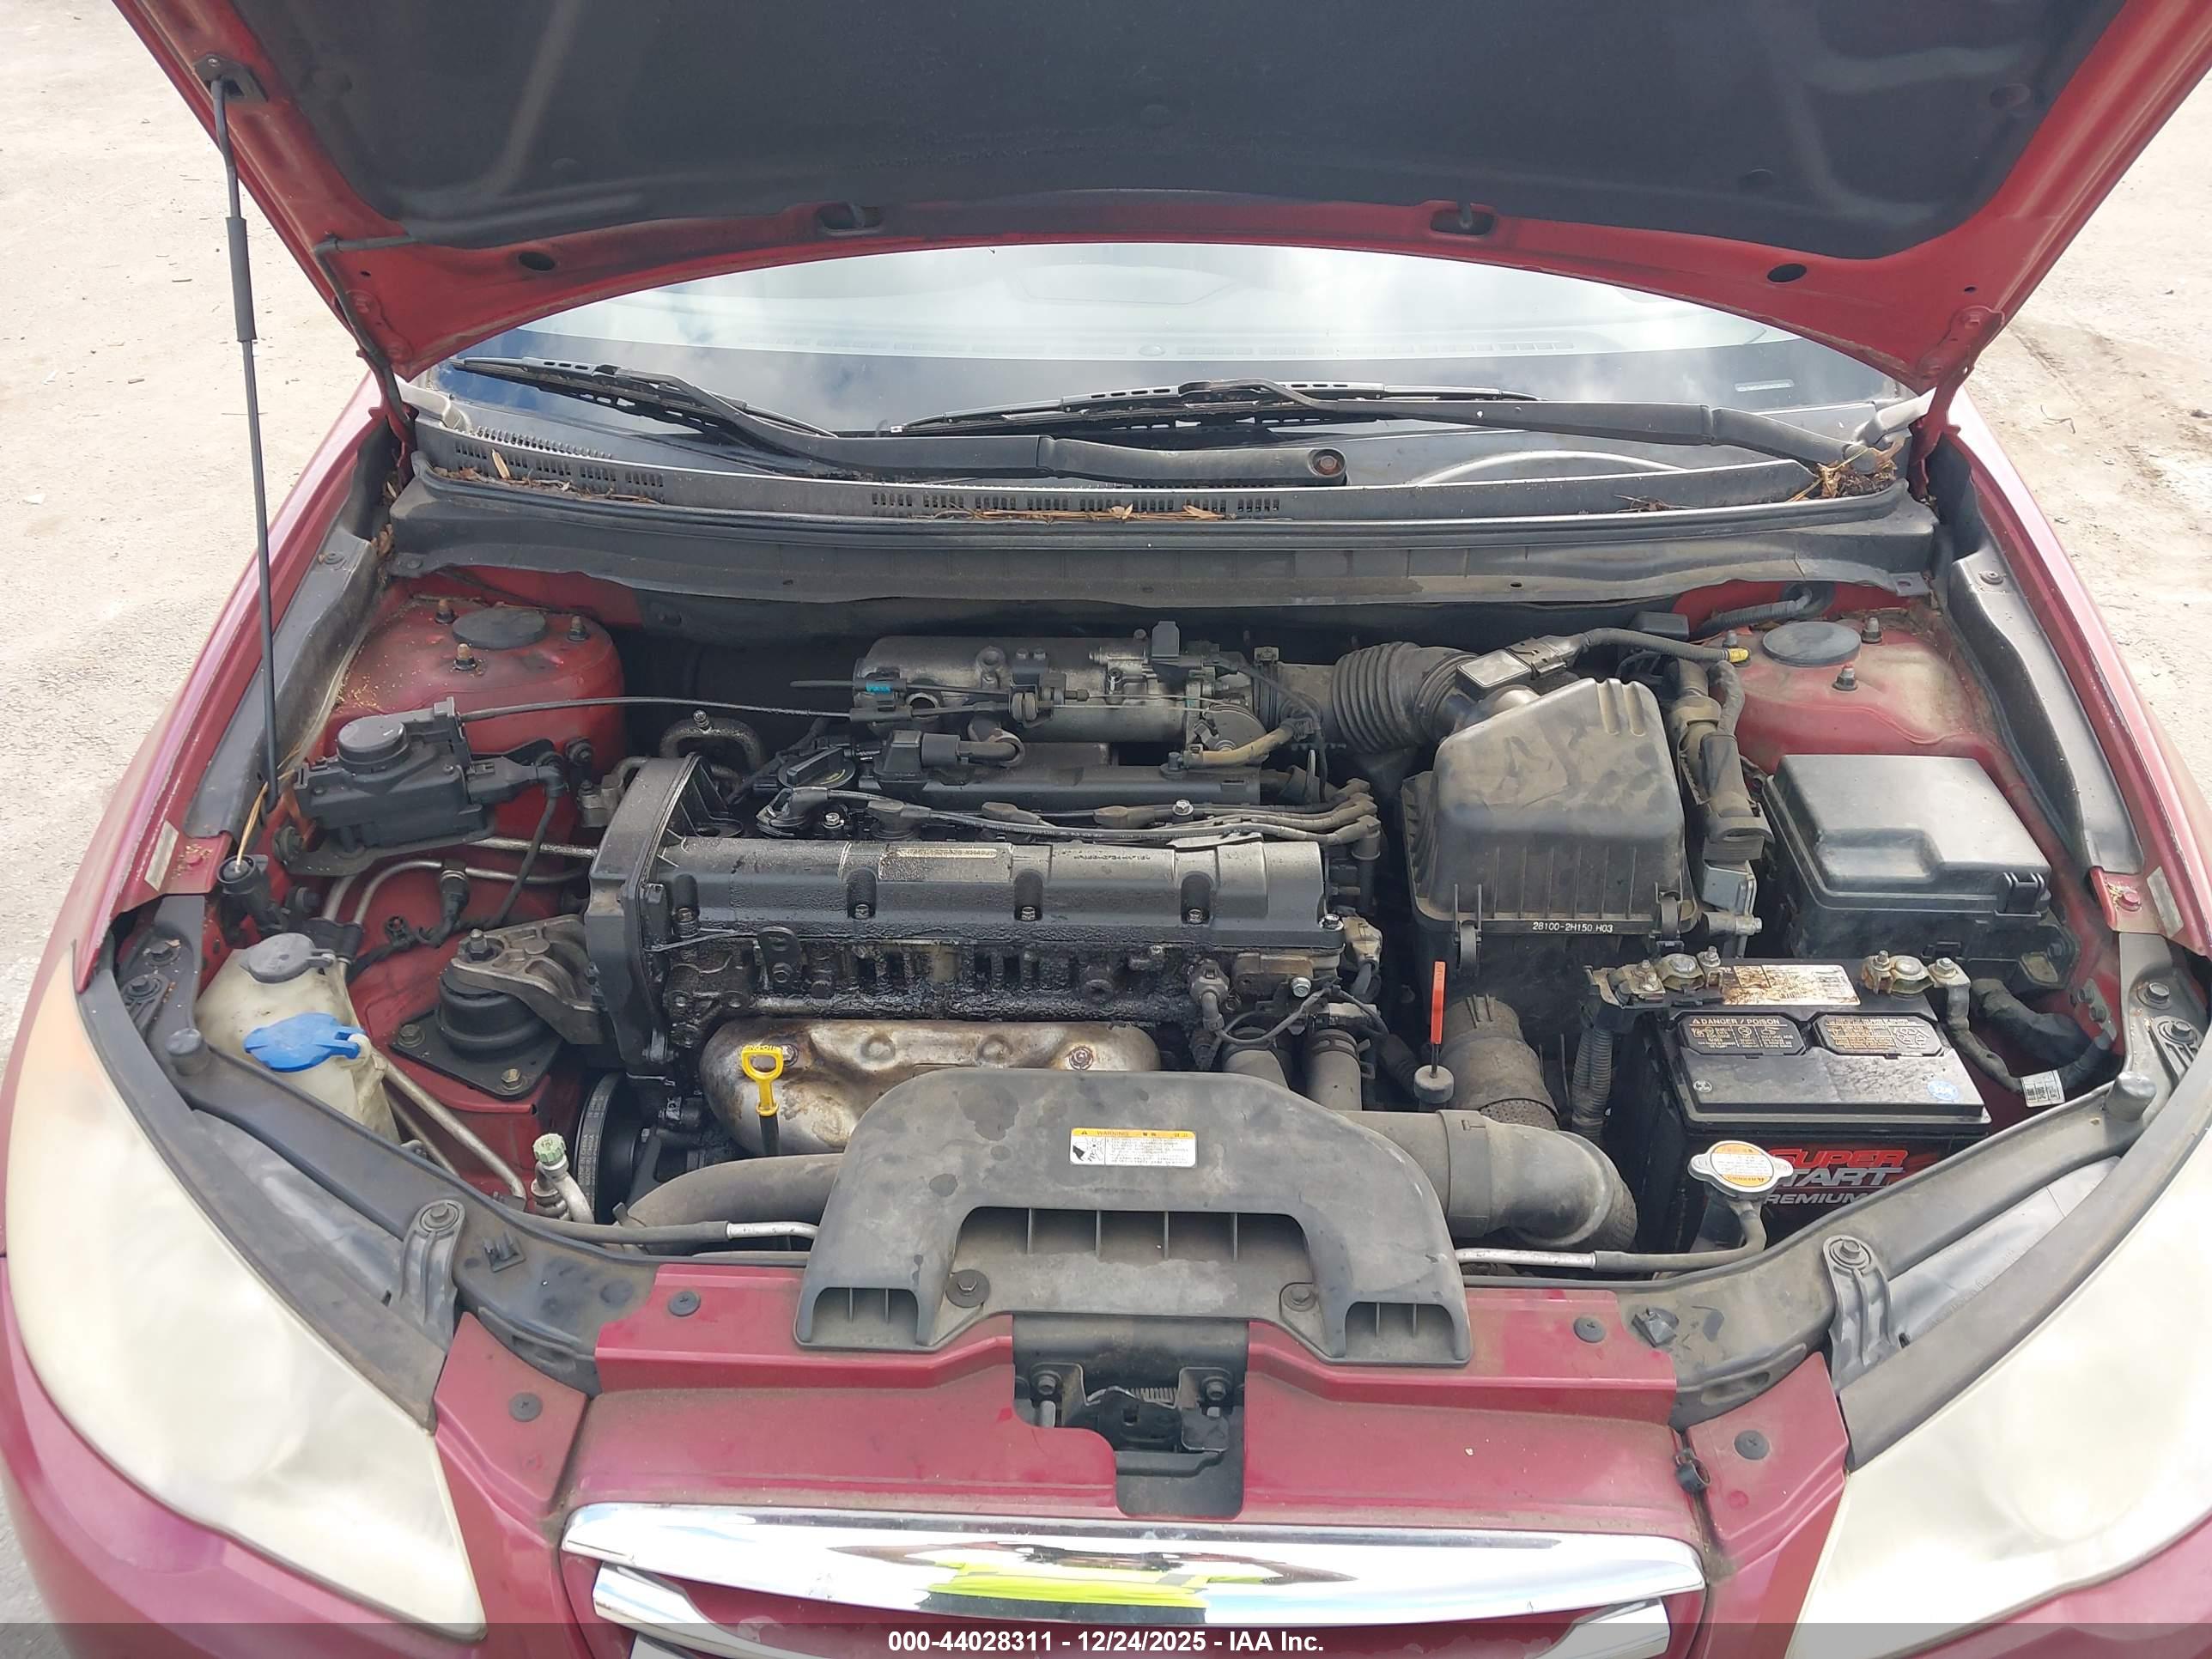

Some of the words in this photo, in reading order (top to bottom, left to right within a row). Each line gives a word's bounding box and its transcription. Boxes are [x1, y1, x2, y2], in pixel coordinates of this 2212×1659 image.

[1533, 921, 1593, 933] 28100-2H150
[1595, 923, 1613, 934] H03
[1767, 1148, 1909, 1169] SUPER
[1778, 1168, 1904, 1187] TART
[1764, 1193, 1869, 1204] REMIUM
